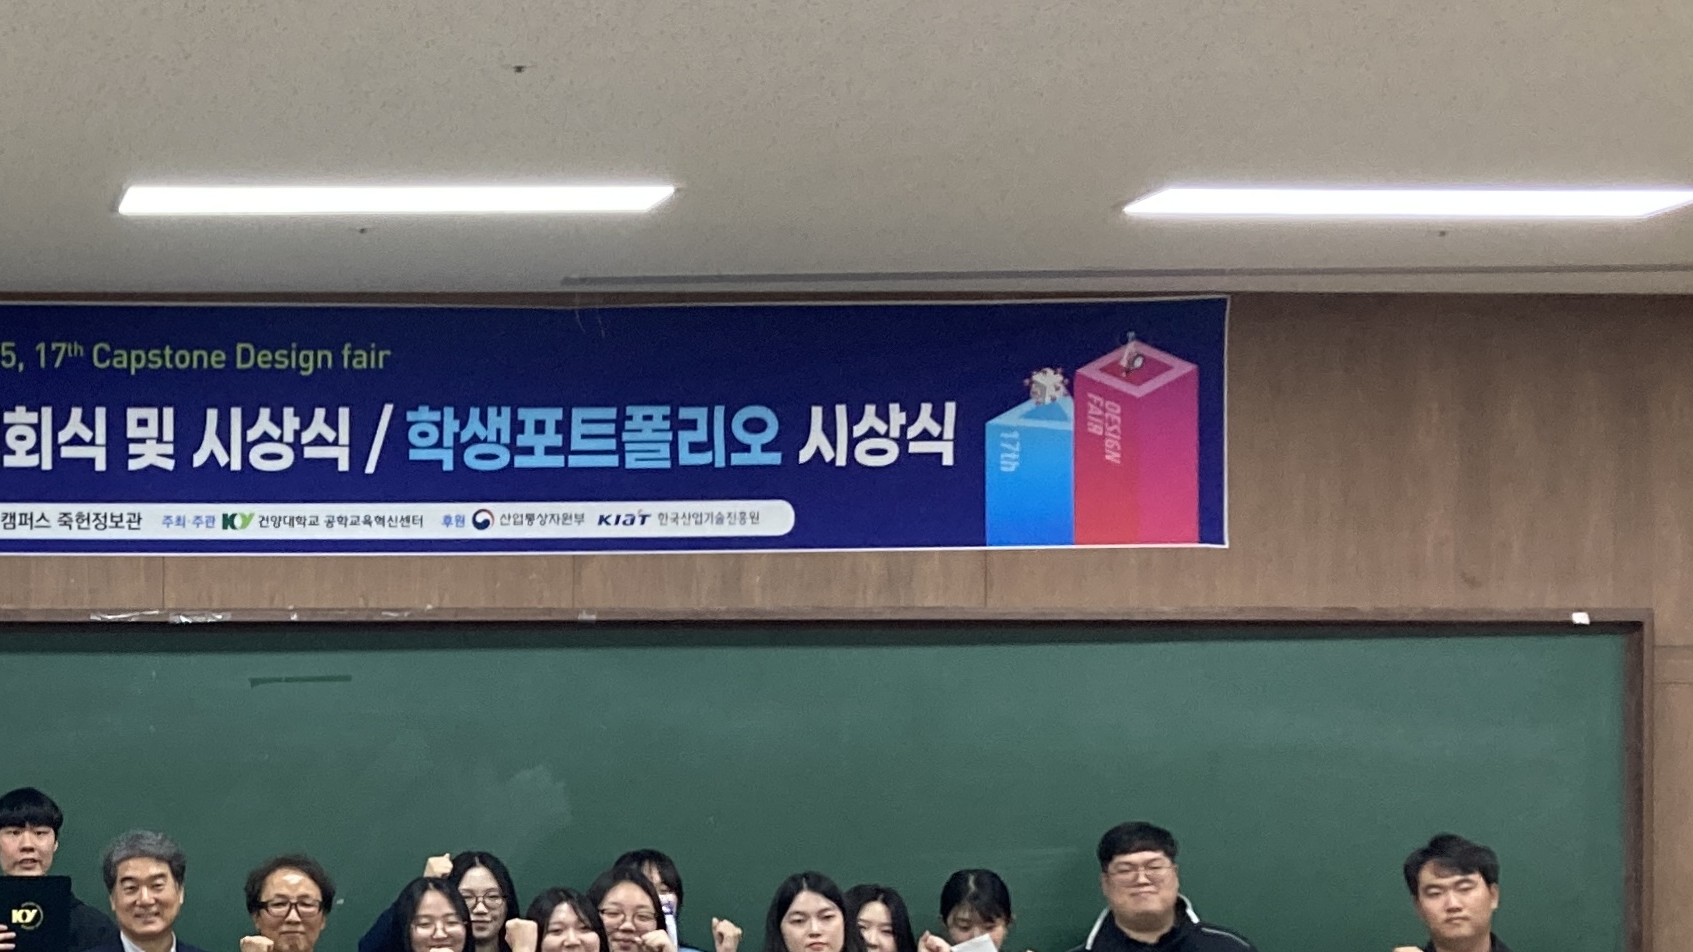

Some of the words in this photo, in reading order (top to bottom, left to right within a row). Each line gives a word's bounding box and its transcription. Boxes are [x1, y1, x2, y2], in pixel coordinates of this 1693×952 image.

[35, 341, 85, 370] 17th
[92, 341, 226, 376] Capstone
[235, 341, 333, 376] Design
[341, 342, 391, 371] fair
[125, 406, 176, 470] 및
[192, 405, 351, 472] 시상식
[406, 405, 782, 470] 학생포트폴리오
[798, 401, 957, 468] 시상식
[1, 511, 51, 531] 캠퍼스
[57, 511, 143, 531] 죽헌정보관
[222, 512, 255, 531] KY
[258, 514, 320, 529] 건양대학교
[324, 514, 424, 529] 공학교육혁신센터
